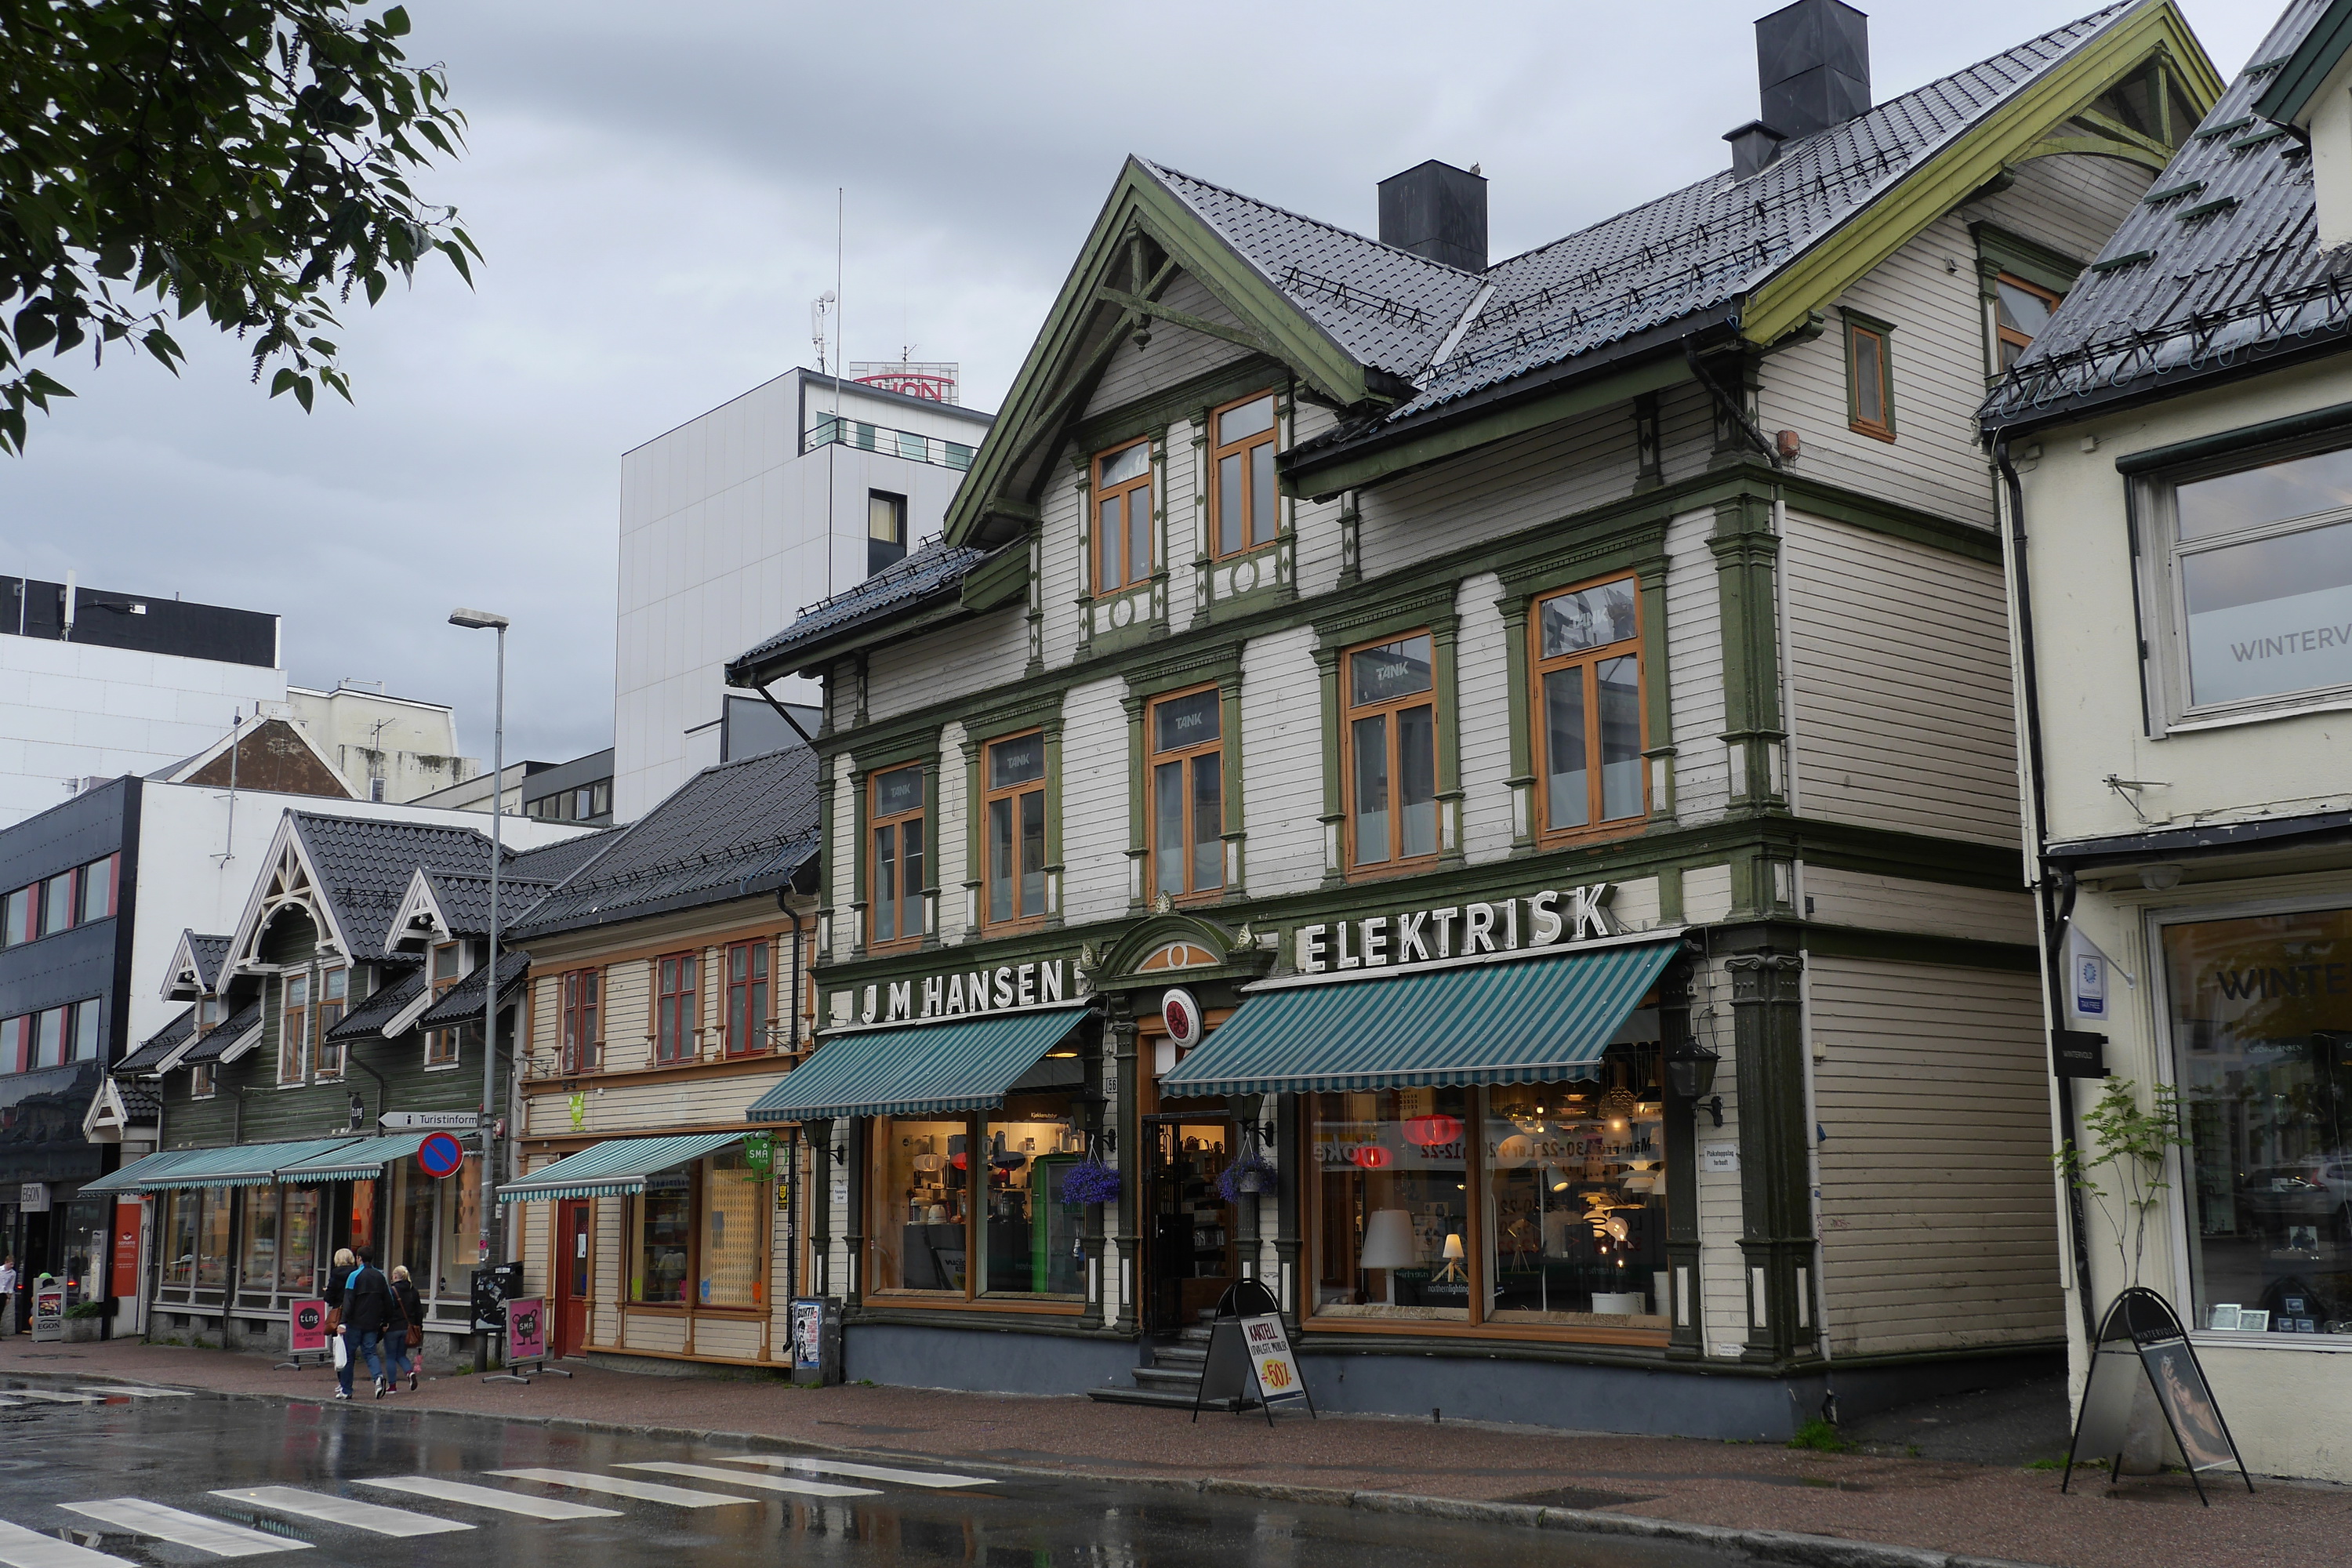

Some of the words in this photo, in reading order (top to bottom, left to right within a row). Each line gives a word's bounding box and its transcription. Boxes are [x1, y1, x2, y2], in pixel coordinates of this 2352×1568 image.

[853, 374, 955, 402] HON
[1570, 608, 1609, 630] TANK
[2230, 623, 2352, 662] WINTERV
[1376, 661, 1409, 681] TANK
[1175, 712, 1202, 730] TANK
[1006, 753, 1030, 769] TANK
[891, 783, 911, 798] TANK
[1305, 882, 1610, 973] ELEKTRISK
[862, 985, 877, 1024] J
[889, 981, 911, 1022] M
[924, 960, 1063, 1018] HANSEN
[2063, 1050, 2093, 1059] WINTERVOLD
[2249, 1045, 2274, 1054] GEORG
[2275, 1044, 2303, 1053] JENSEN
[1109, 1080, 1116, 1091] 56
[352, 1107, 364, 1120] ting
[419, 1115, 477, 1127] Turistinform
[749, 1143, 768, 1159] SMÅ
[22, 1186, 41, 1202] EGON
[299, 1314, 318, 1324] ting
[797, 1307, 815, 1318] BUKTA
[519, 1317, 534, 1331] SMÅ
[1248, 1323, 1278, 1342] KARTELL
[2134, 1327, 2178, 1340] WINTERVOLD
